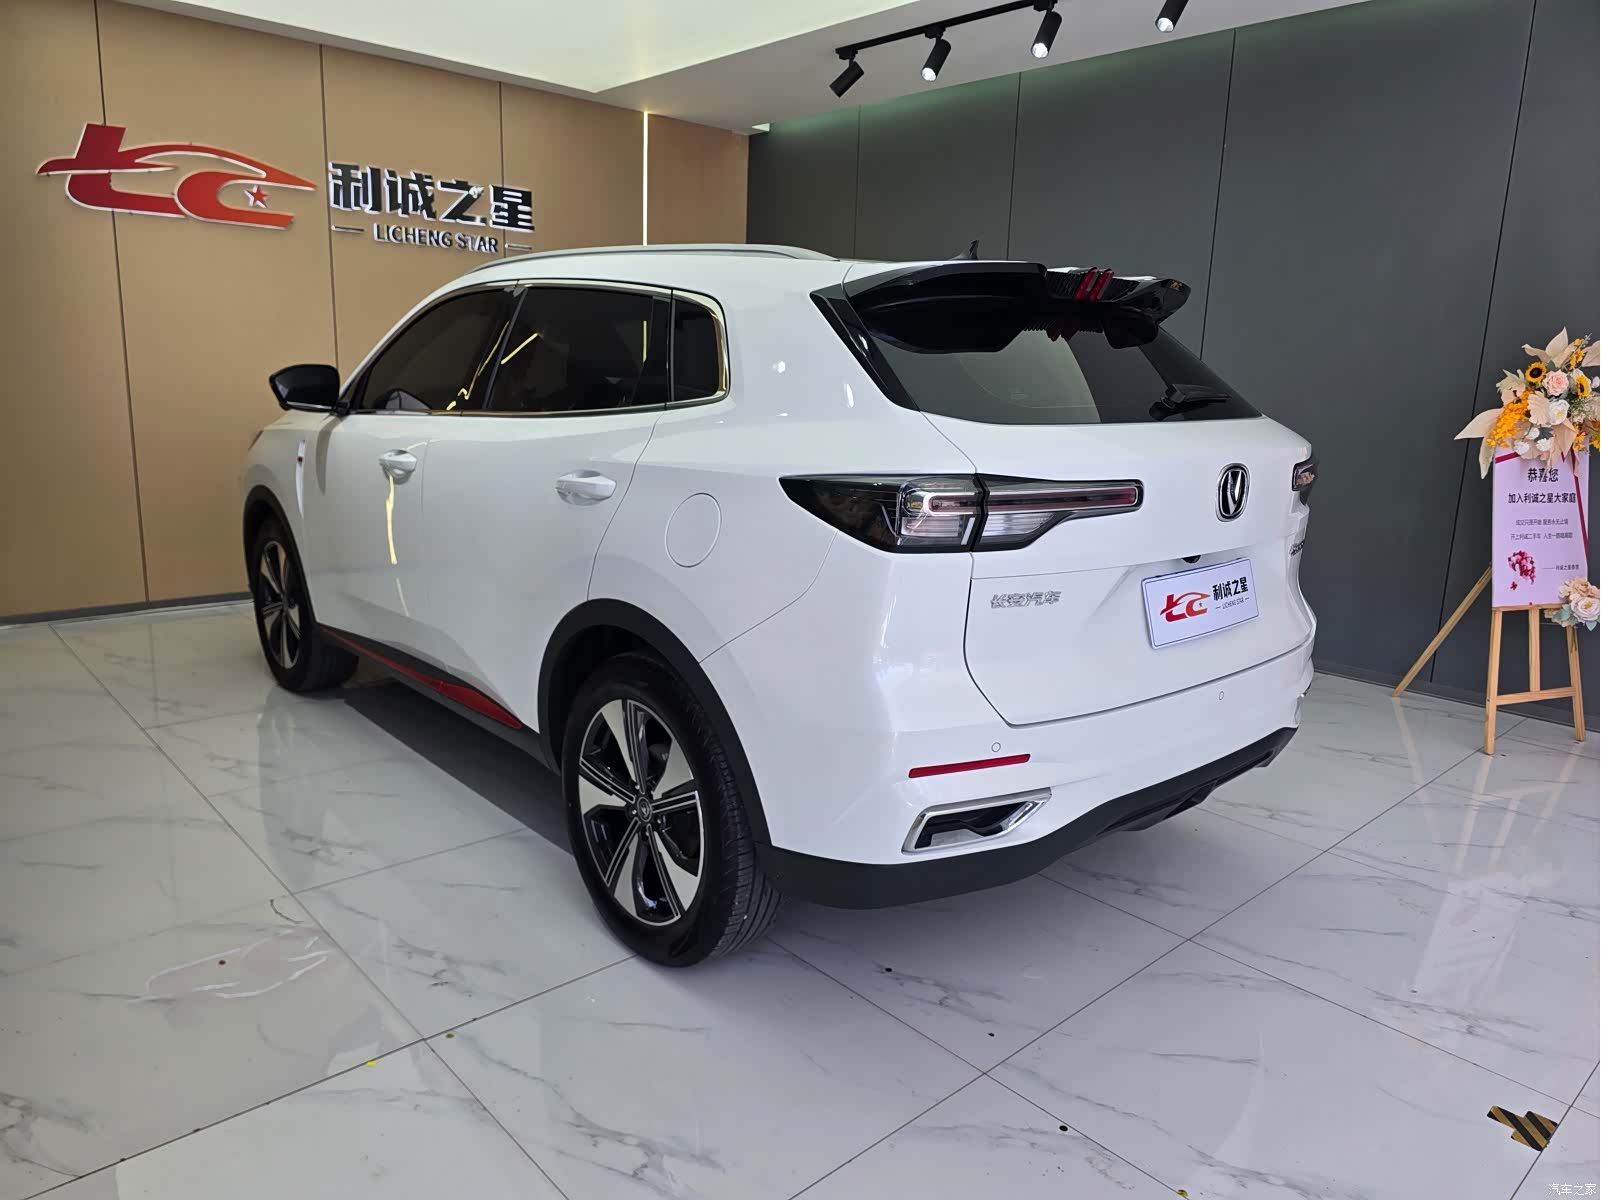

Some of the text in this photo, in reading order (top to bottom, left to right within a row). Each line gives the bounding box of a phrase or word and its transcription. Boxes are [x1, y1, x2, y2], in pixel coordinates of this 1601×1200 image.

[329, 161, 535, 232] 利诚之星
[373, 222, 498, 253] LICHENG STAR
[1527, 467, 1559, 483] 恭喜您
[1508, 492, 1577, 504] 加入利诚之星大家庭
[990, 590, 1062, 609] 长安汽车
[1212, 577, 1248, 601] 利诚之星
